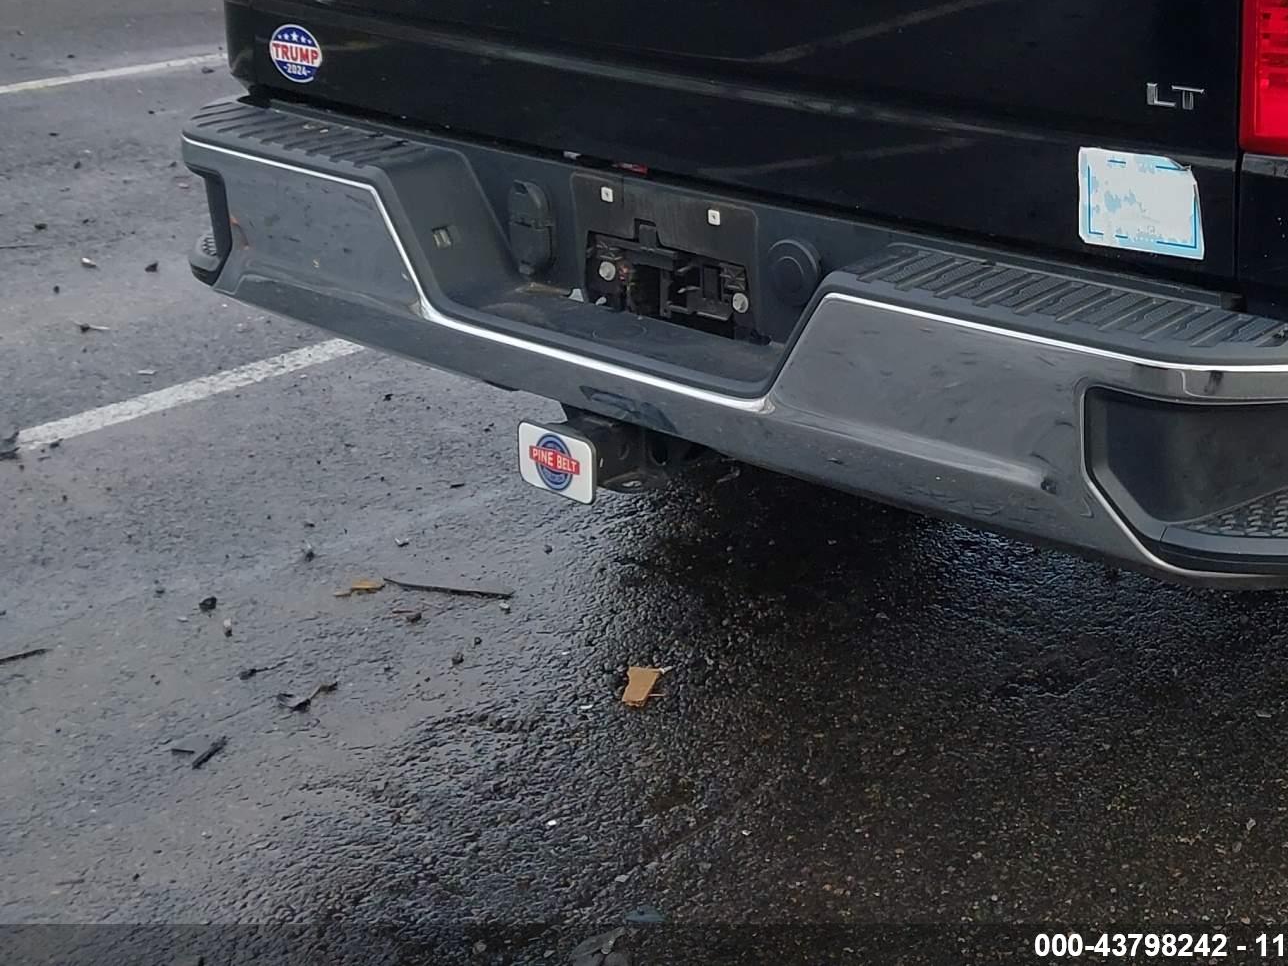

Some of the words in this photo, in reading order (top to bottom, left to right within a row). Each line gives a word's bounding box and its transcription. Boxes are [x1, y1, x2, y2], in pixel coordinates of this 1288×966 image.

[272, 43, 318, 64] TRUMP
[1146, 82, 1205, 110] LT
[532, 448, 554, 466] PINE
[557, 455, 577, 472] BELT
